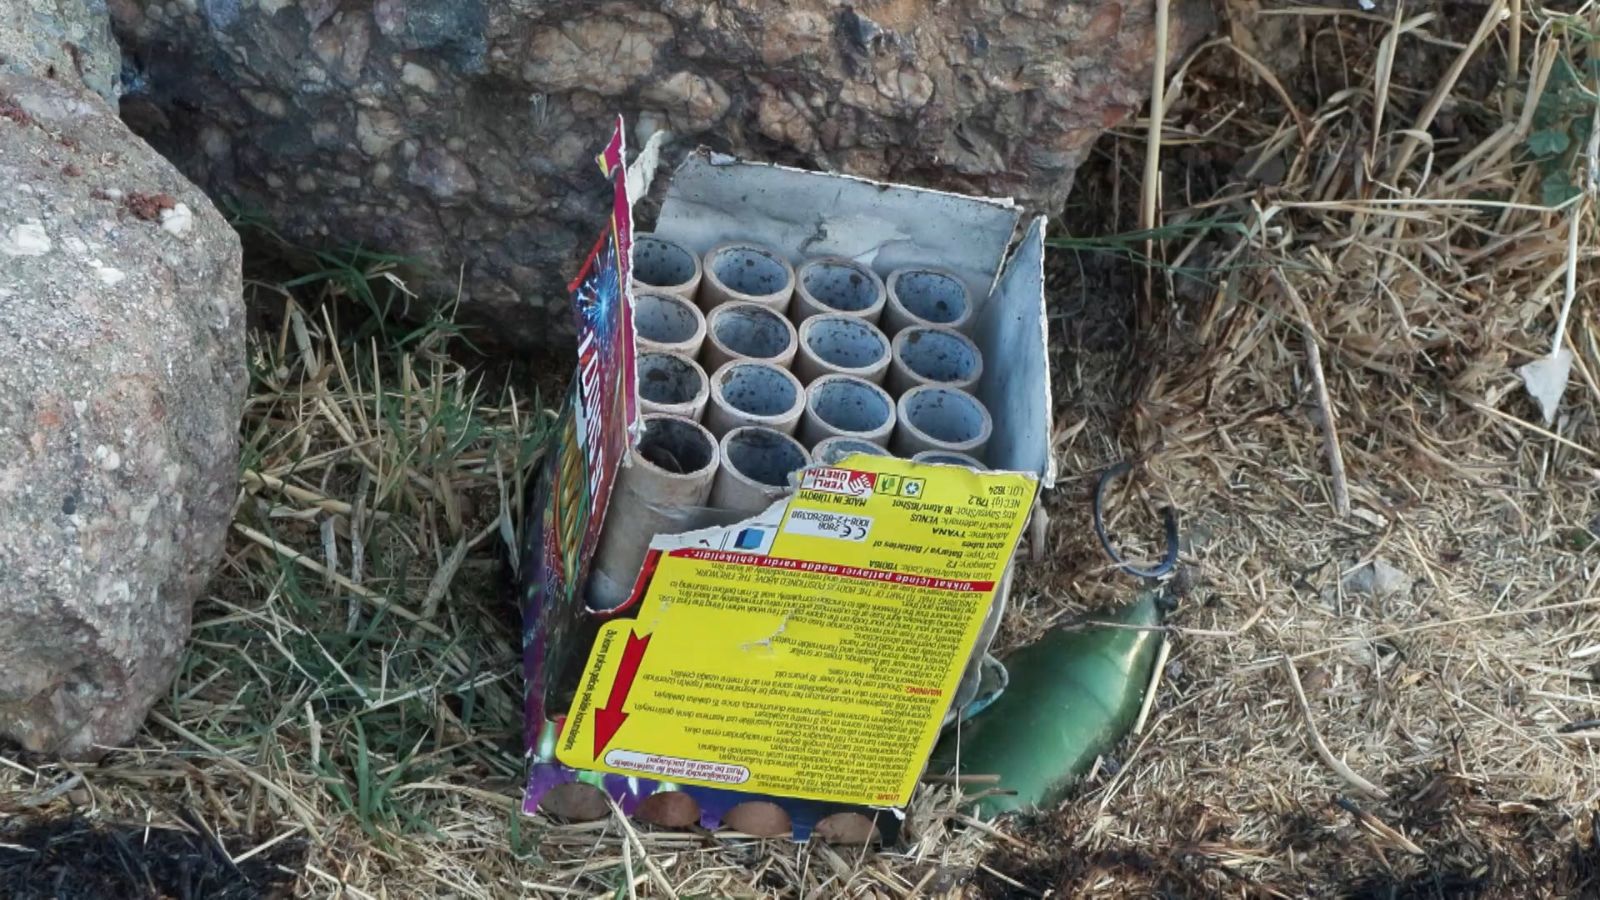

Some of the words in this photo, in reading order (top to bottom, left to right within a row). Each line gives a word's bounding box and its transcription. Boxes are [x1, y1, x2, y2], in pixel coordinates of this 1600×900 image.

[806, 467, 849, 480] ÜRETİM
[811, 478, 845, 490] YERLİ
[832, 495, 842, 503] IN
[842, 496, 867, 506] MADE
[909, 514, 939, 523] VENUS
[930, 527, 966, 536] TYANA
[800, 563, 837, 572] madde
